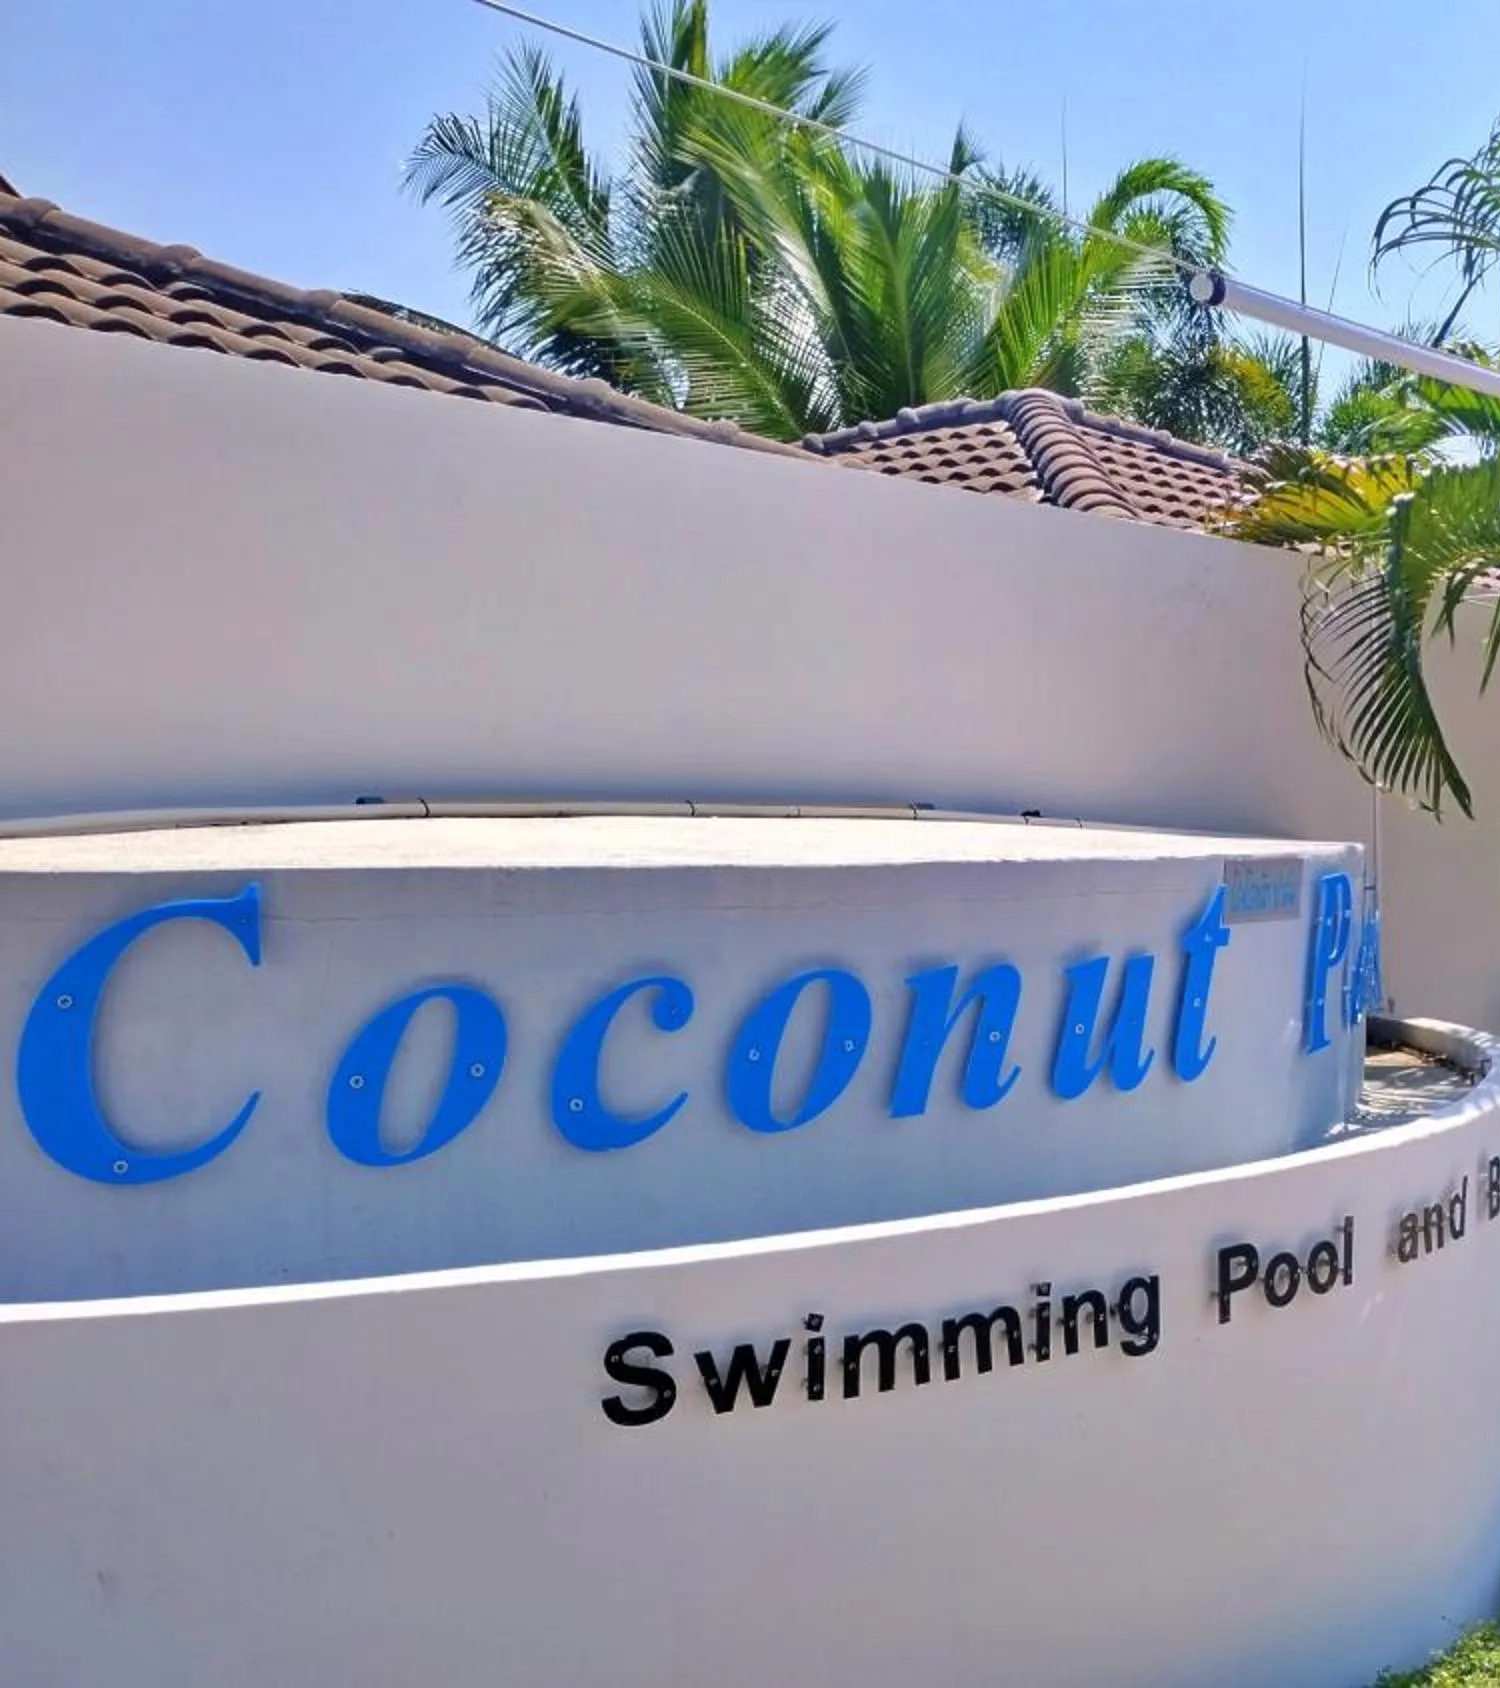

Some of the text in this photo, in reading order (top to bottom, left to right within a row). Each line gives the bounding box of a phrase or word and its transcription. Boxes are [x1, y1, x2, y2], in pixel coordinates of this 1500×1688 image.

[17, 883, 1231, 1186] Coconut
[601, 1275, 1161, 1427] Swimming
[1217, 1217, 1354, 1325] Pool
[1398, 1177, 1467, 1263] and
